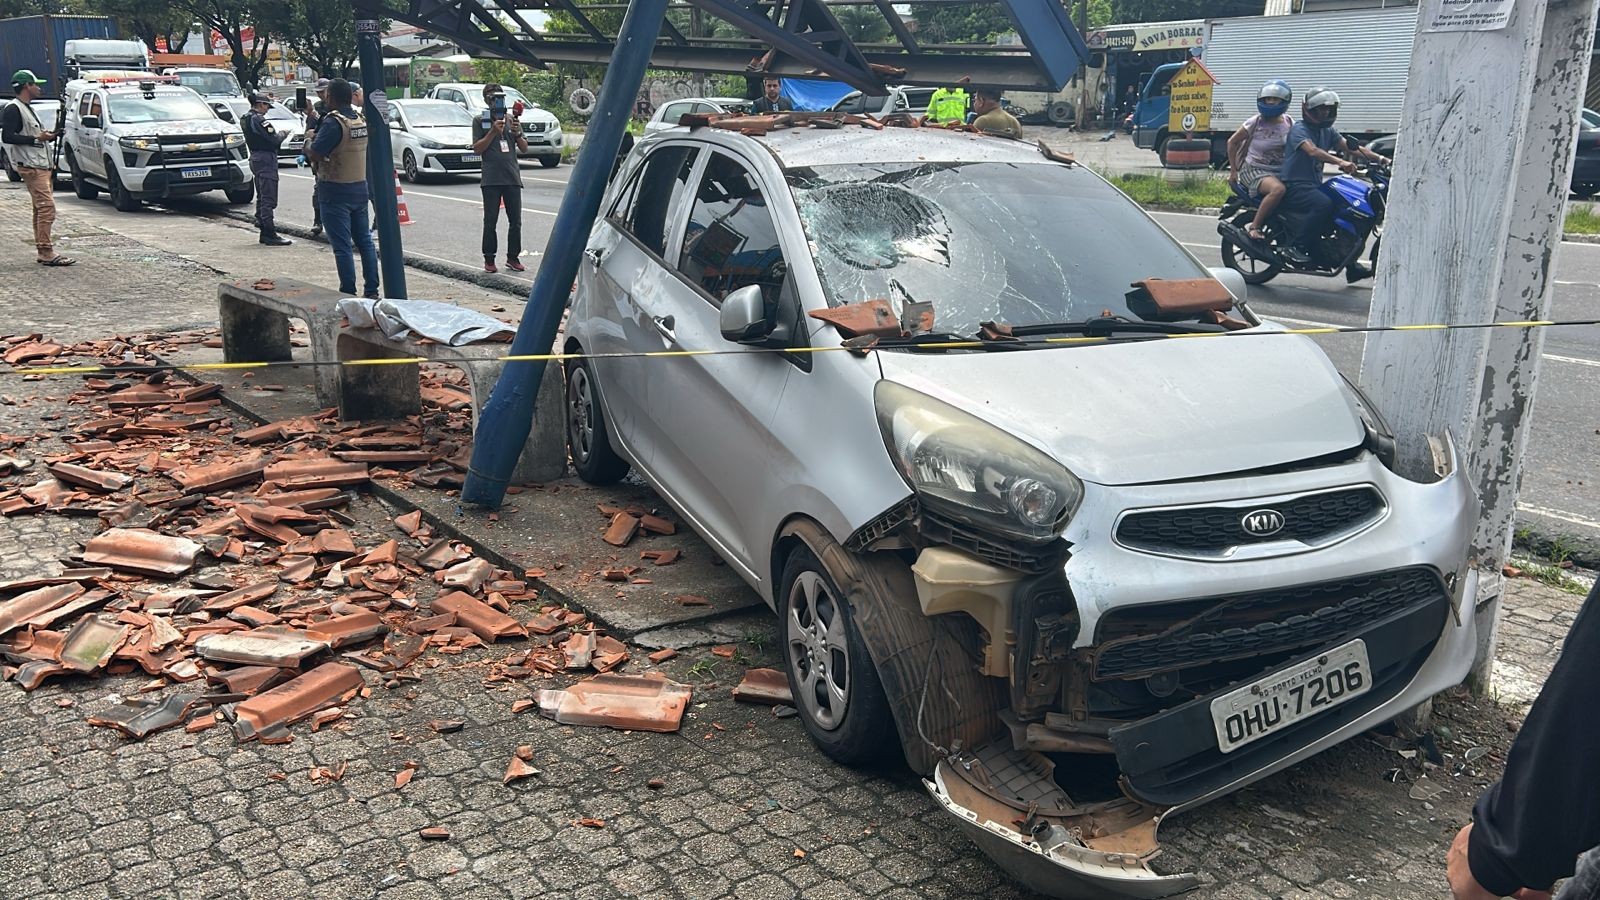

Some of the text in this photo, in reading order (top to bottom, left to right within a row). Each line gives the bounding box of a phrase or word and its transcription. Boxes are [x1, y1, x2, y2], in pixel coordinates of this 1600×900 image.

[1141, 31, 1167, 48] NOVA
[1186, 65, 1197, 75] Crê
[1249, 514, 1280, 531] KIA
[1299, 665, 1323, 681] VELHO
